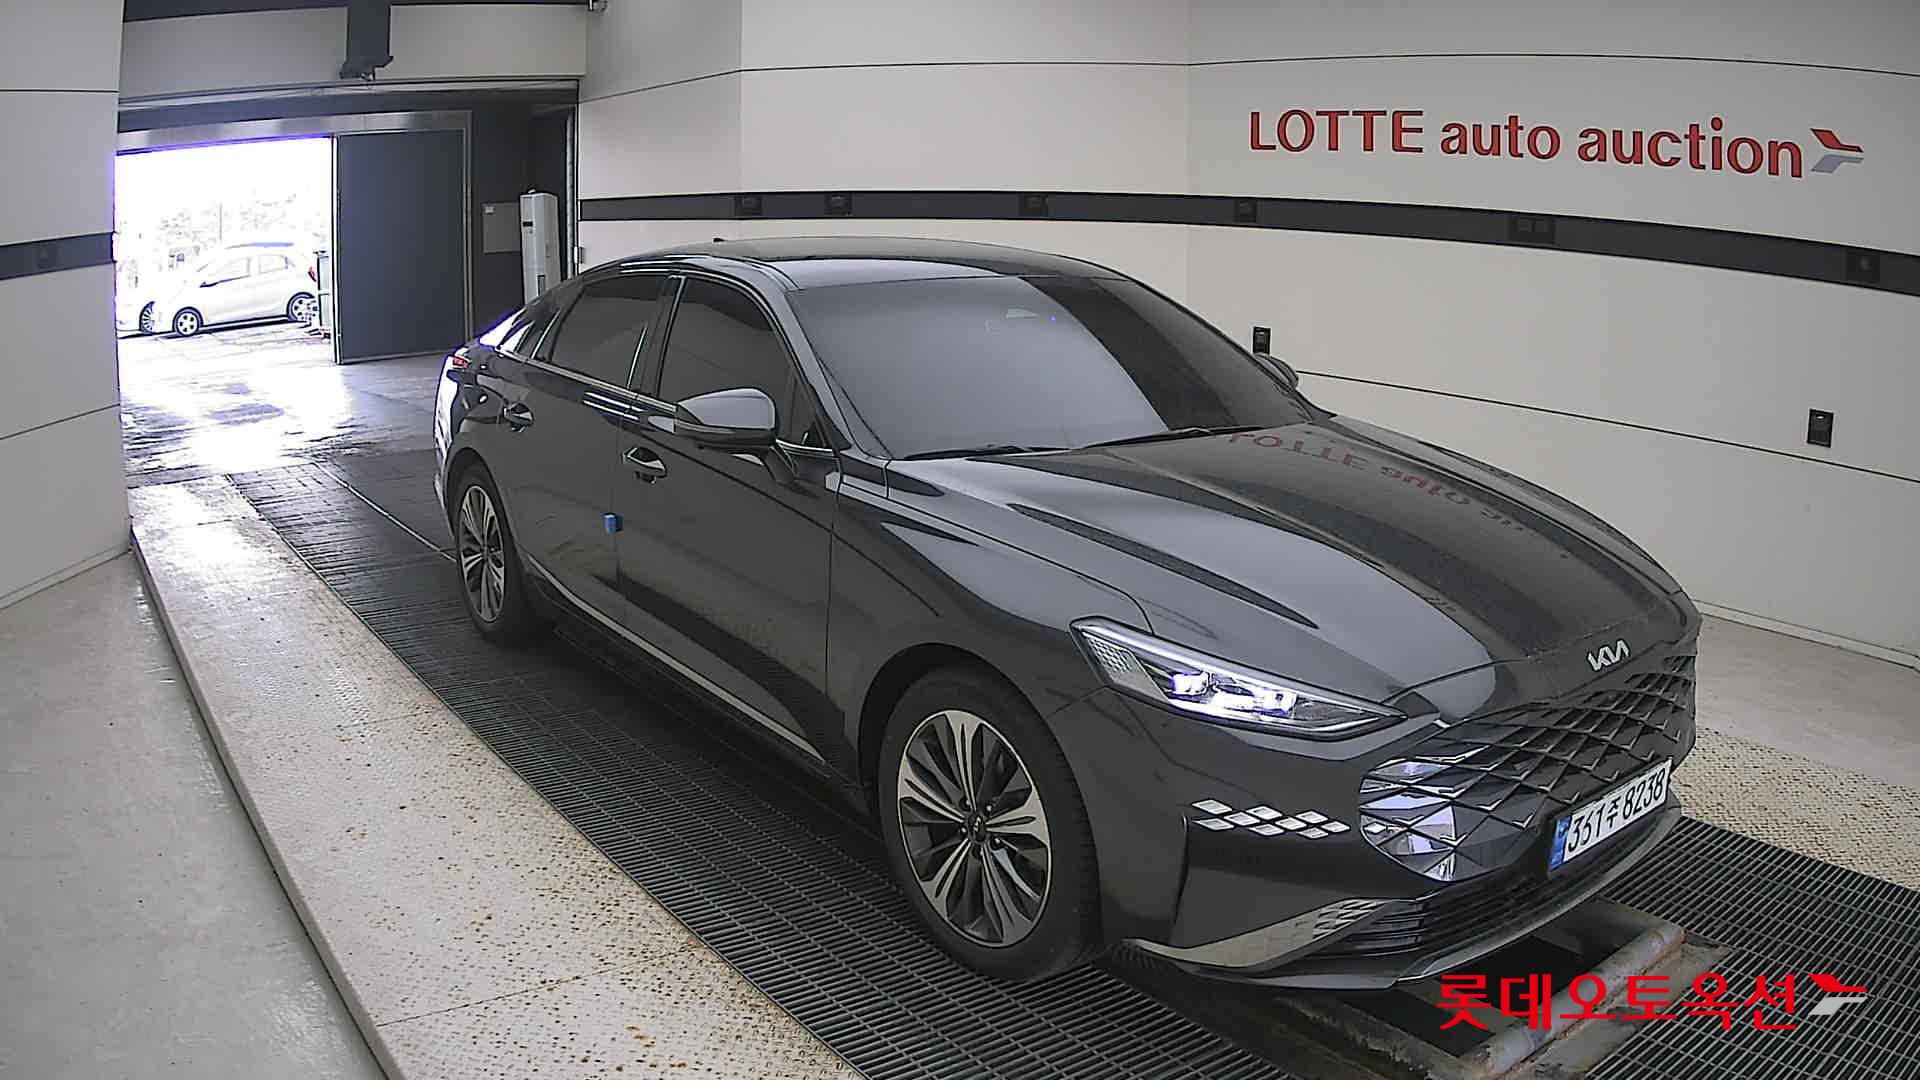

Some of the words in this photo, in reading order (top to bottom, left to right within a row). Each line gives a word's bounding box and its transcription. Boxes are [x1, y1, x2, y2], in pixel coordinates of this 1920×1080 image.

[1249, 110, 1424, 154] LOTTE
[1440, 115, 1561, 160] auto
[1577, 117, 1803, 179] auction
[1586, 639, 1630, 672] KIA
